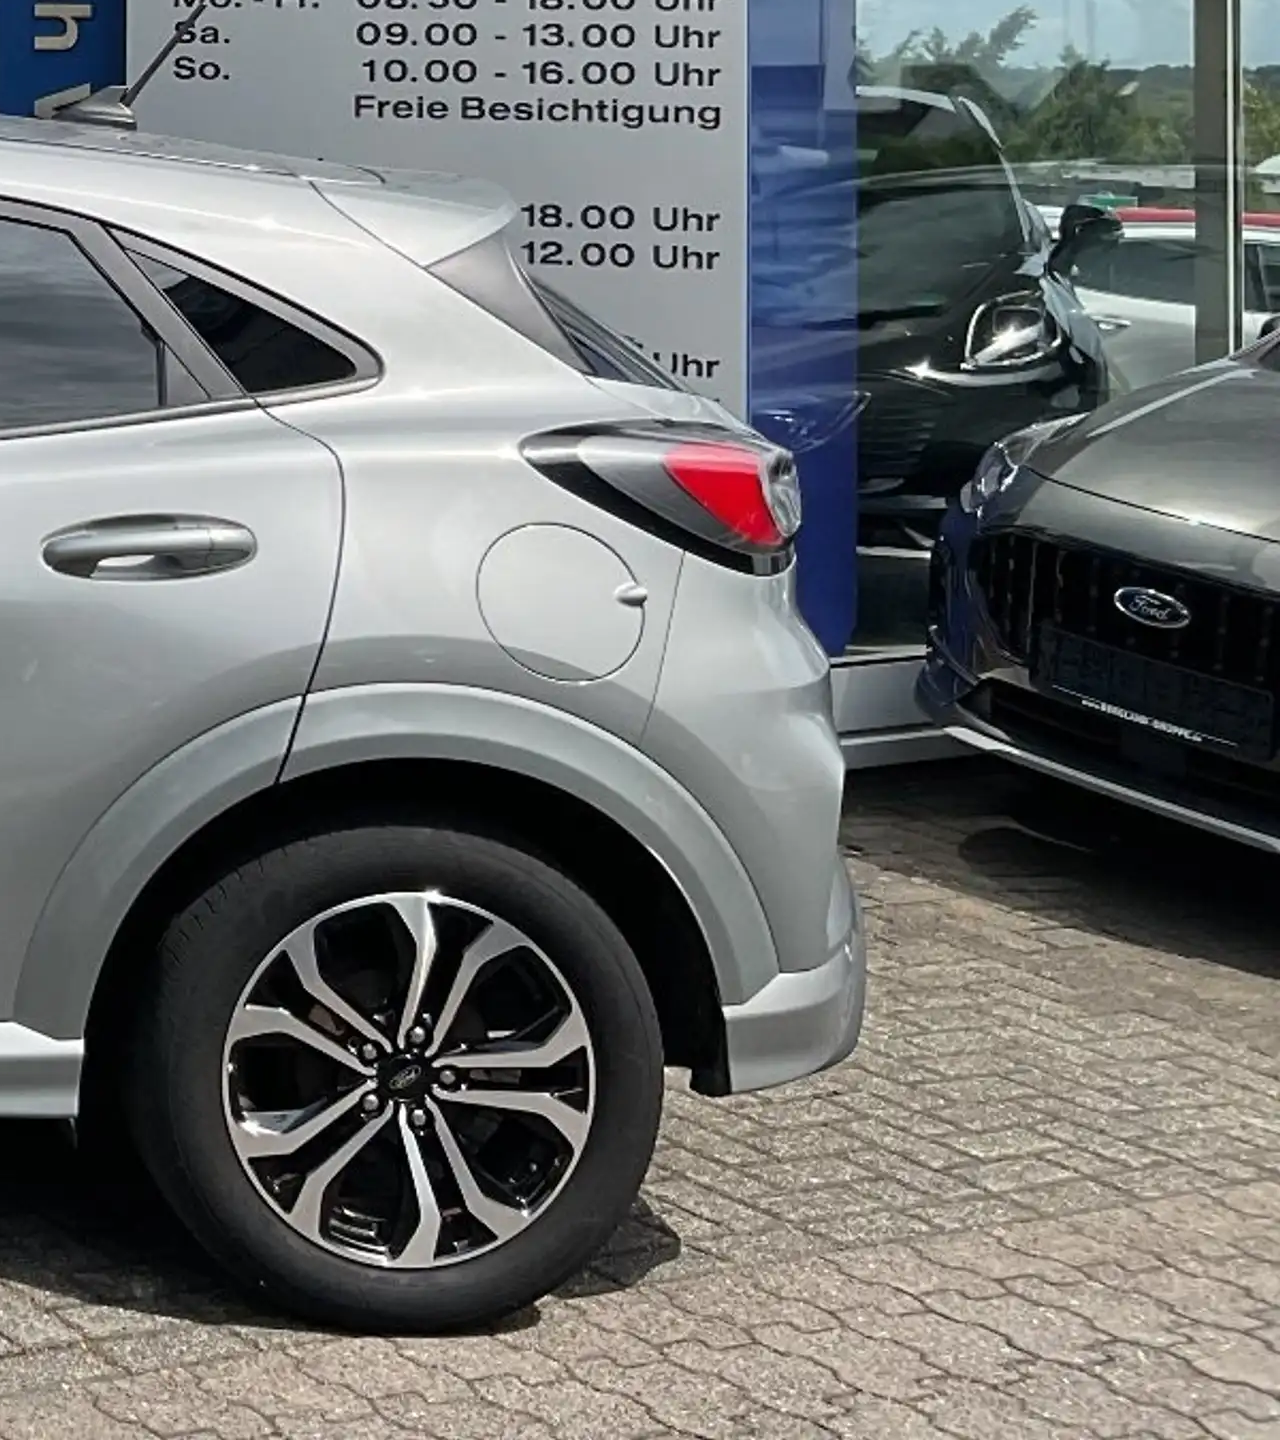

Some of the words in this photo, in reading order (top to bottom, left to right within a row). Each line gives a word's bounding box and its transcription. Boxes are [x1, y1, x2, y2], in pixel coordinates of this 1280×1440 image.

[174, 20, 231, 45] Sa.
[356, 21, 478, 47] 09.00
[522, 23, 636, 48] 13.00
[654, 24, 722, 49] Uhr
[173, 55, 231, 81] So.
[361, 59, 478, 84] 10.00
[522, 61, 636, 86] 16.00
[654, 62, 722, 87] Uhr
[353, 95, 450, 120] Freie
[460, 96, 722, 131] Besichtigung
[520, 203, 636, 230] 18.00
[652, 206, 721, 232] Uhr
[520, 240, 636, 268] 12.00
[652, 244, 721, 270] Uhr
[1128, 594, 1173, 621] Ford
